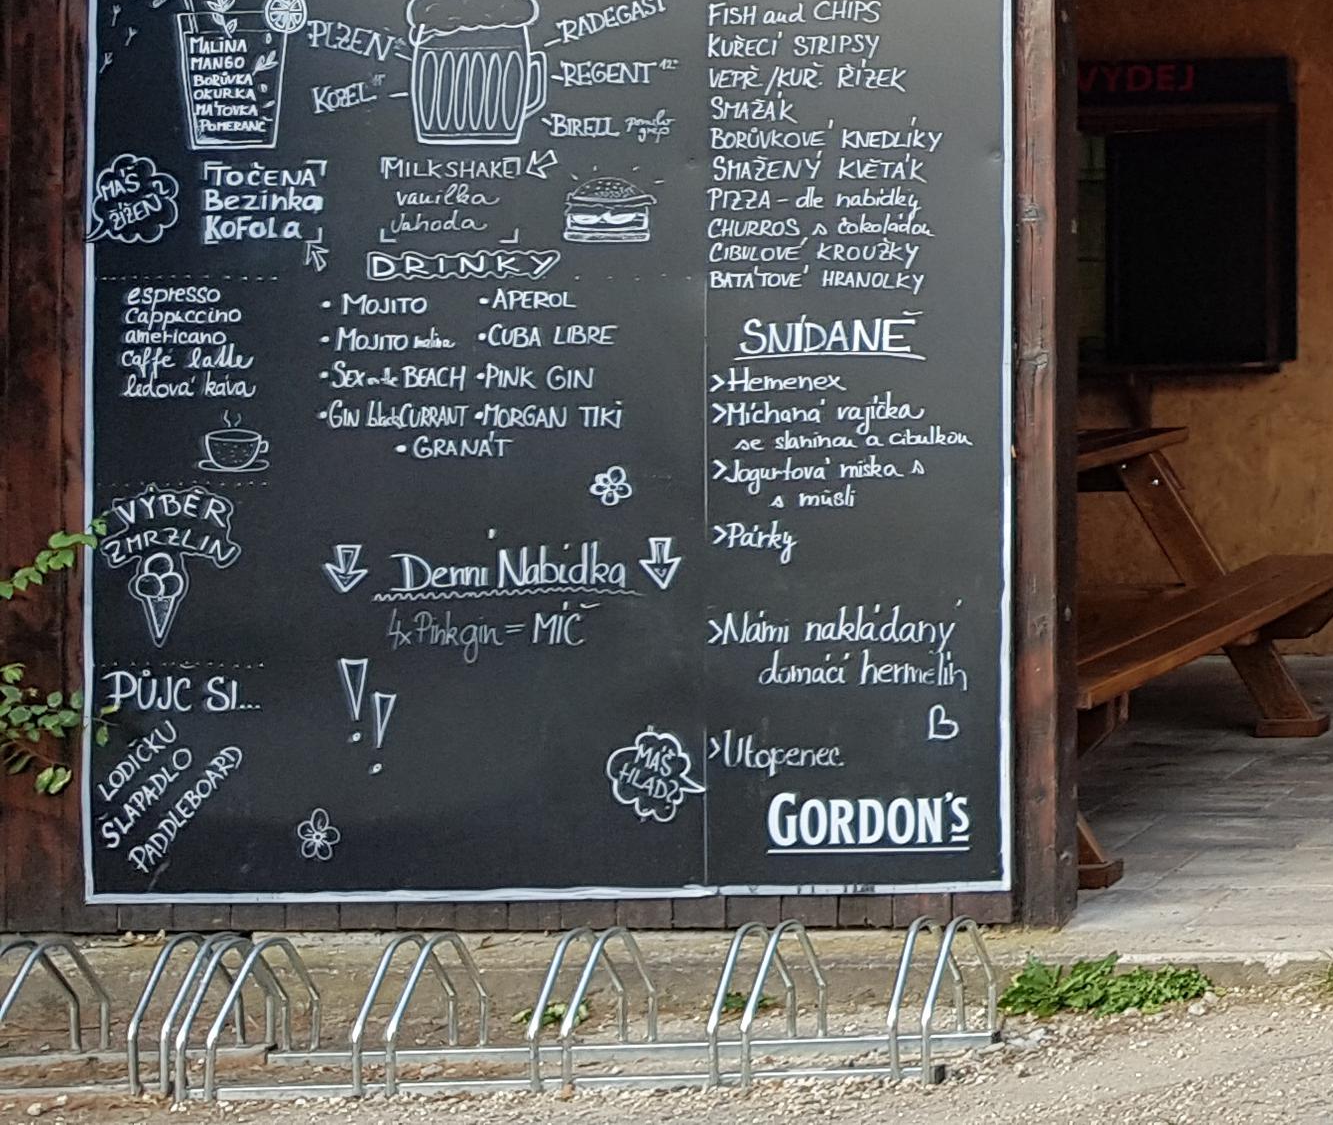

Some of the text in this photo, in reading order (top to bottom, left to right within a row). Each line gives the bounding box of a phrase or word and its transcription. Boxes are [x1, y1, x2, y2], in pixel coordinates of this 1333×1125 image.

[708, 0, 882, 27] FISH and CHIPS
[708, 31, 880, 60] KUŘECÍ STRIPSY
[190, 56, 246, 71] MANGO
[560, 60, 657, 87] REGENT
[193, 87, 257, 102] OKURKA
[312, 82, 377, 114] KOZEL
[710, 91, 798, 124] SMAŽÁK
[194, 101, 258, 116] MÁTOVKA
[199, 116, 274, 133] POMERANČ
[549, 113, 621, 138] BIRELL
[710, 117, 944, 152] BORŮVKOVÉ KNEDLÍKY
[385, 157, 515, 179] MILKSHAKE
[712, 151, 823, 182] SMAŽENÝ
[396, 184, 500, 207] vanilka
[707, 187, 771, 211] PIZZA
[795, 186, 825, 210] dle
[708, 214, 936, 240] CHURROS s čokoládou
[371, 255, 554, 278] DRINKY
[708, 237, 919, 269] CIBULOVÉ KROUŽKY
[710, 265, 925, 295] BATÁTOVÉ HRANOLKY
[127, 287, 221, 313] espresso
[341, 293, 428, 315] MOJITO
[492, 288, 577, 311] APEROL
[125, 330, 227, 344] americano
[335, 326, 409, 351] MOJITO
[487, 324, 619, 348] CUBA LIBRE
[738, 311, 924, 354] SNÍDANĚ
[122, 371, 257, 398] ledová káva
[332, 360, 366, 388] SEX
[401, 365, 466, 391] BEACH
[484, 363, 595, 390] PINK GIN
[329, 399, 360, 428] GIN
[483, 403, 567, 428] MORGAN
[413, 430, 514, 459] GRANÁT
[734, 426, 974, 451] se slaninou a cibulkou
[840, 455, 905, 478] miska
[117, 486, 227, 528] VÝBĚR
[769, 494, 785, 508] s
[104, 528, 236, 565] ZMRZLIN
[804, 598, 963, 653] nakládaný
[759, 651, 851, 687] domácí
[98, 720, 177, 802] LODIČKU
[128, 746, 243, 874] PADDLEBOARD
